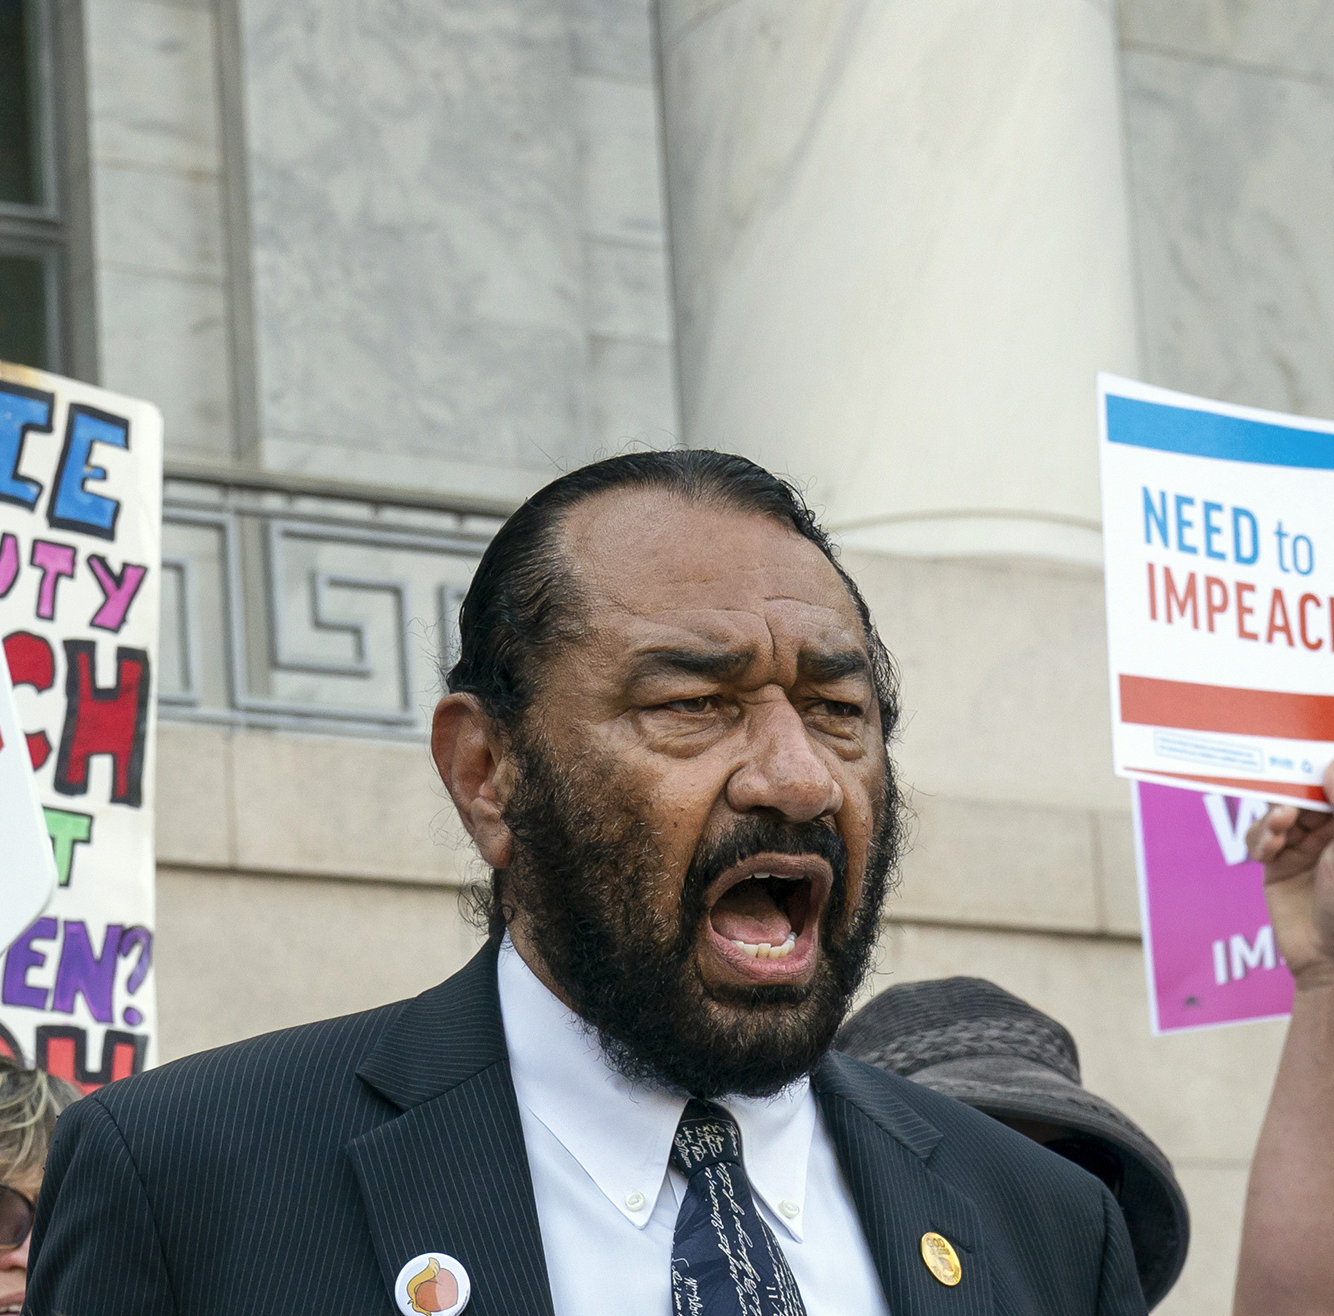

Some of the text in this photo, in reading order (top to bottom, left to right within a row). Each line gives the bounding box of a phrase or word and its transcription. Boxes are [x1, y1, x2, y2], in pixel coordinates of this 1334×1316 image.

[1141, 486, 1316, 576] NEED to
[722, 1190, 746, 1215] of
